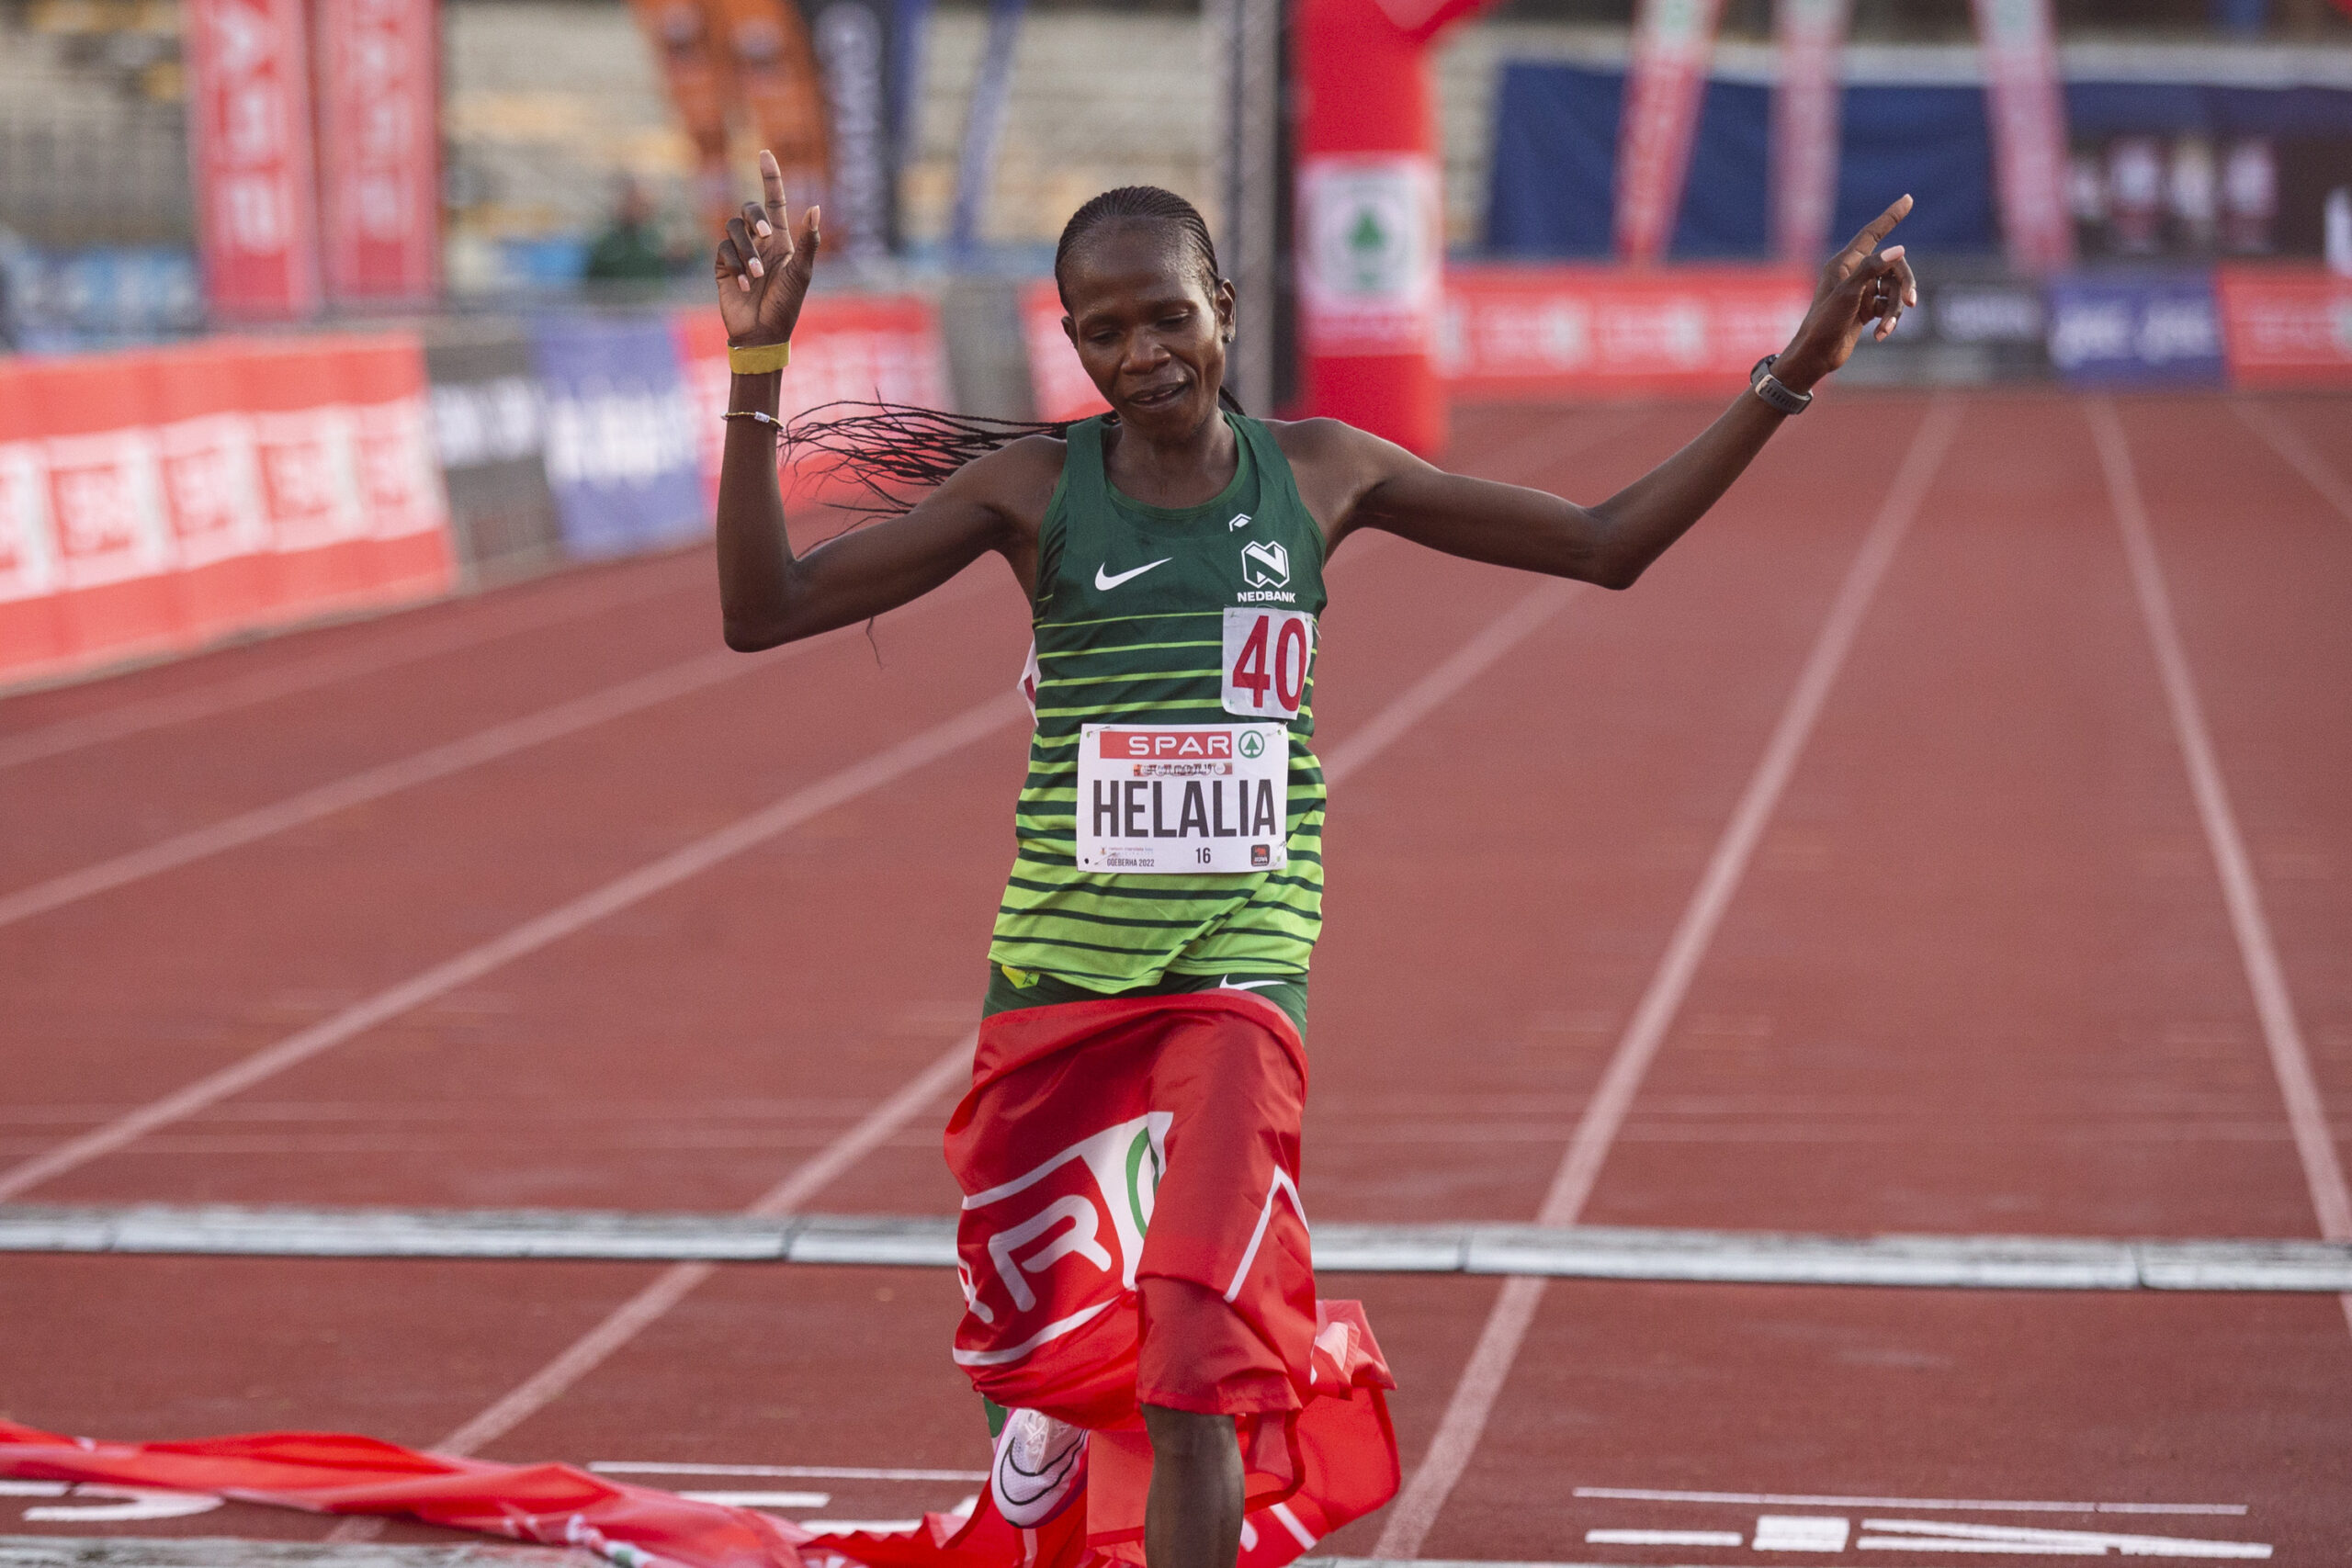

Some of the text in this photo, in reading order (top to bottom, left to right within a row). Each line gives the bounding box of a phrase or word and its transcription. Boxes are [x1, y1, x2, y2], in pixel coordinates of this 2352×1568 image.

[1237, 591, 1296, 604] NEDBANK
[1232, 615, 1306, 711] 40
[1128, 736, 1230, 756] SPAR
[1092, 779, 1276, 838] HELALIA
[1138, 859, 1155, 867] 2022
[1195, 848, 1211, 863] 16
